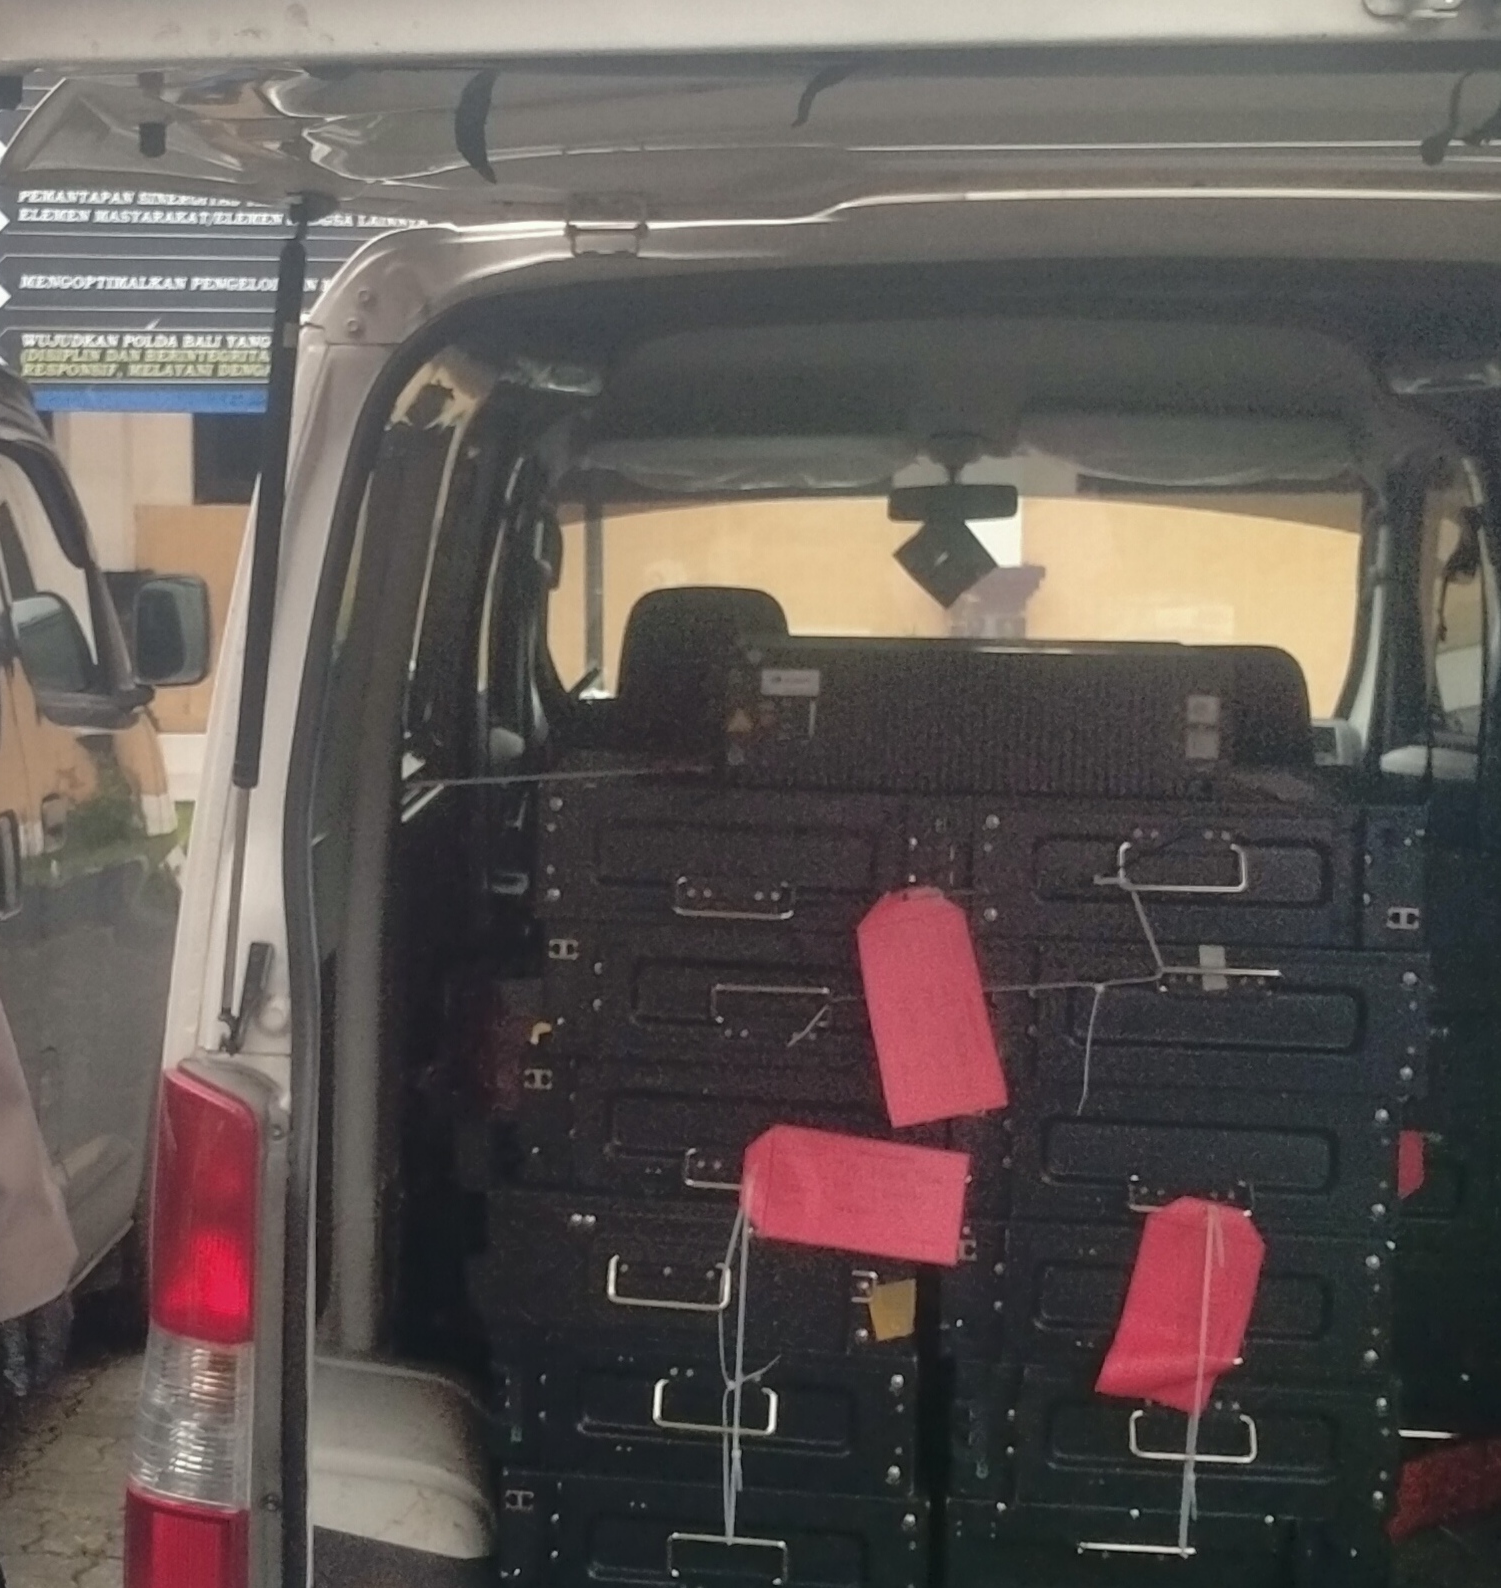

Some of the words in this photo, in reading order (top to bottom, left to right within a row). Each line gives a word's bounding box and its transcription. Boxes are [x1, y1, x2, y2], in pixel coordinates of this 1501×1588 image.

[17, 189, 135, 205] PEMANTAPAN
[17, 208, 92, 223] ELEMEN
[19, 273, 188, 291] MENGOPTIMALKAN
[21, 333, 120, 349] WUJUDKAN
[122, 334, 178, 349] POLDA
[181, 335, 223, 349] BALI
[225, 335, 272, 350] YANG
[104, 349, 142, 363] DAN
